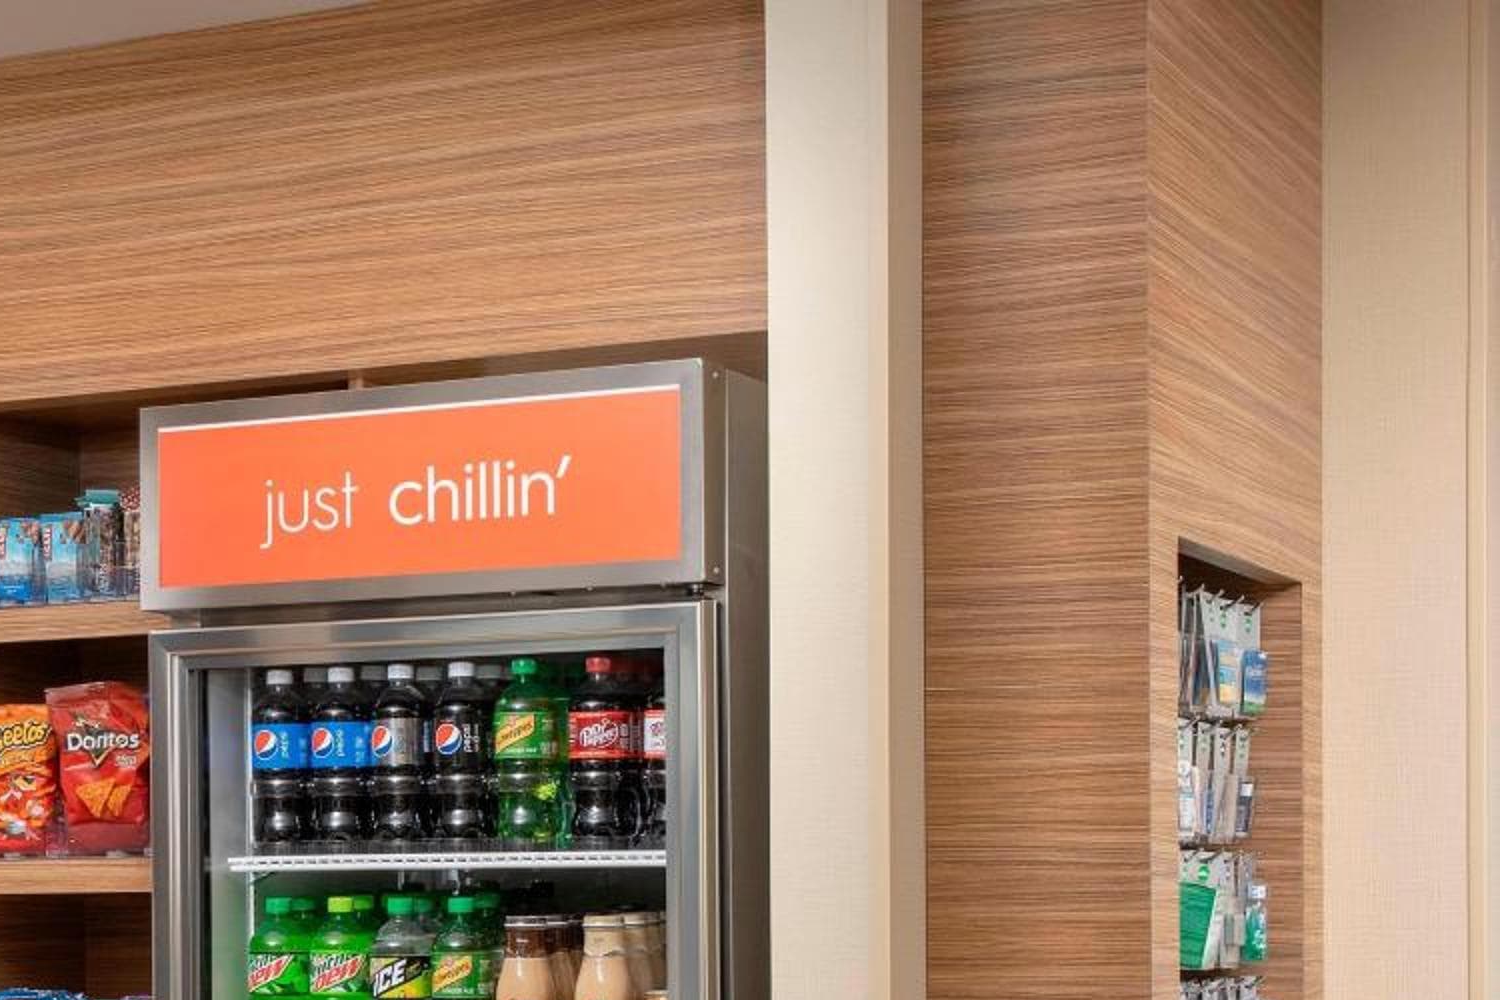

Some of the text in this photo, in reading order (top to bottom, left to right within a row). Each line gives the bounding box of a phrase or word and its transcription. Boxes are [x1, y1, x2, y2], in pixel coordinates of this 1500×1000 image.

[260, 454, 572, 550] just chillin'
[66, 731, 141, 751] Doritos
[374, 959, 407, 999] ICE
